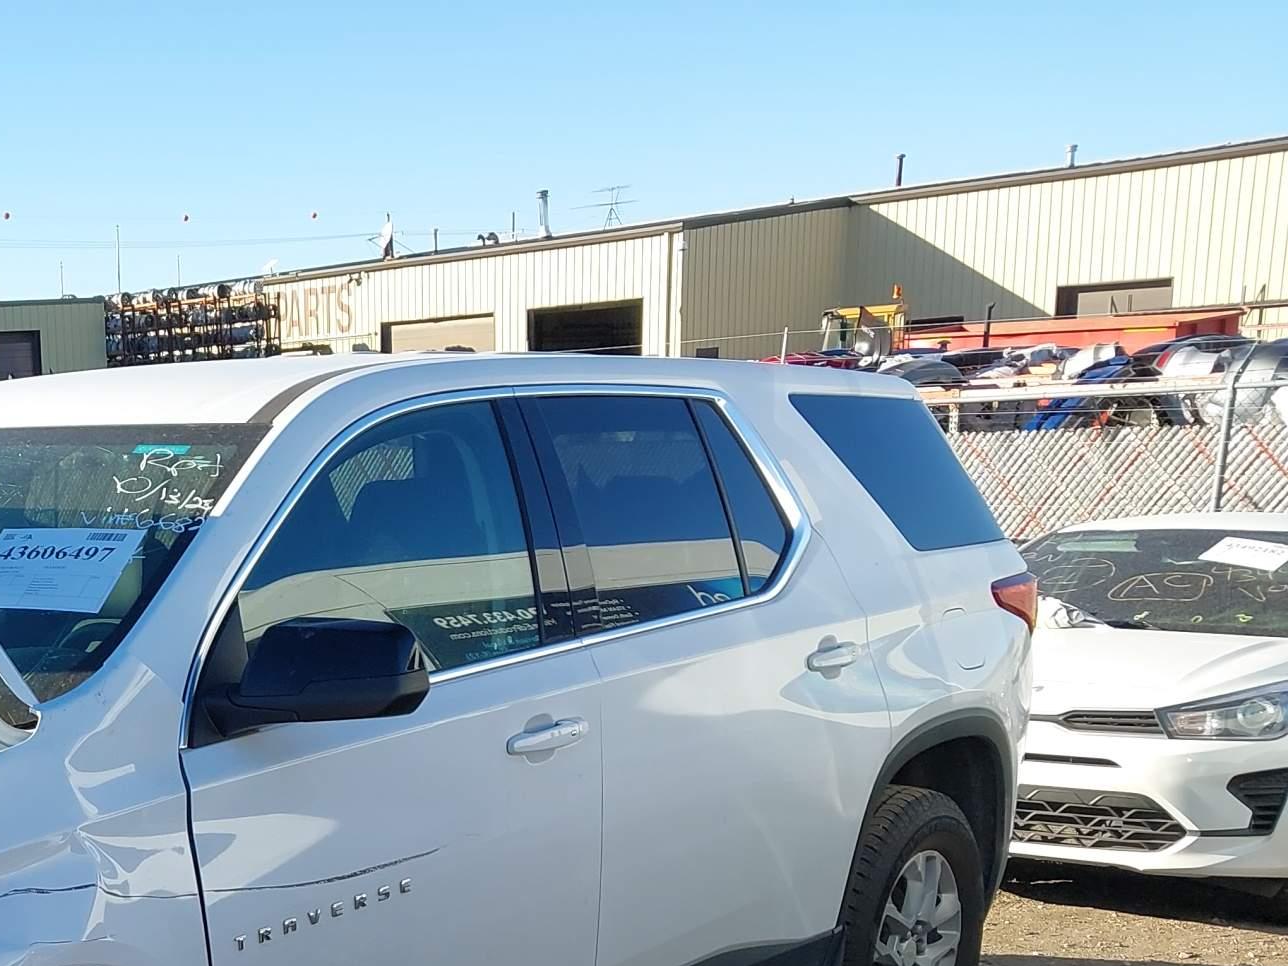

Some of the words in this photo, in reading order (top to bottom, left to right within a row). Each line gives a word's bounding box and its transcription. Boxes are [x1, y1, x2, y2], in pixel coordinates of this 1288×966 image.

[279, 270, 354, 338] PARTS
[0, 544, 116, 563] 43606497
[233, 878, 412, 951] TRAVERSE
